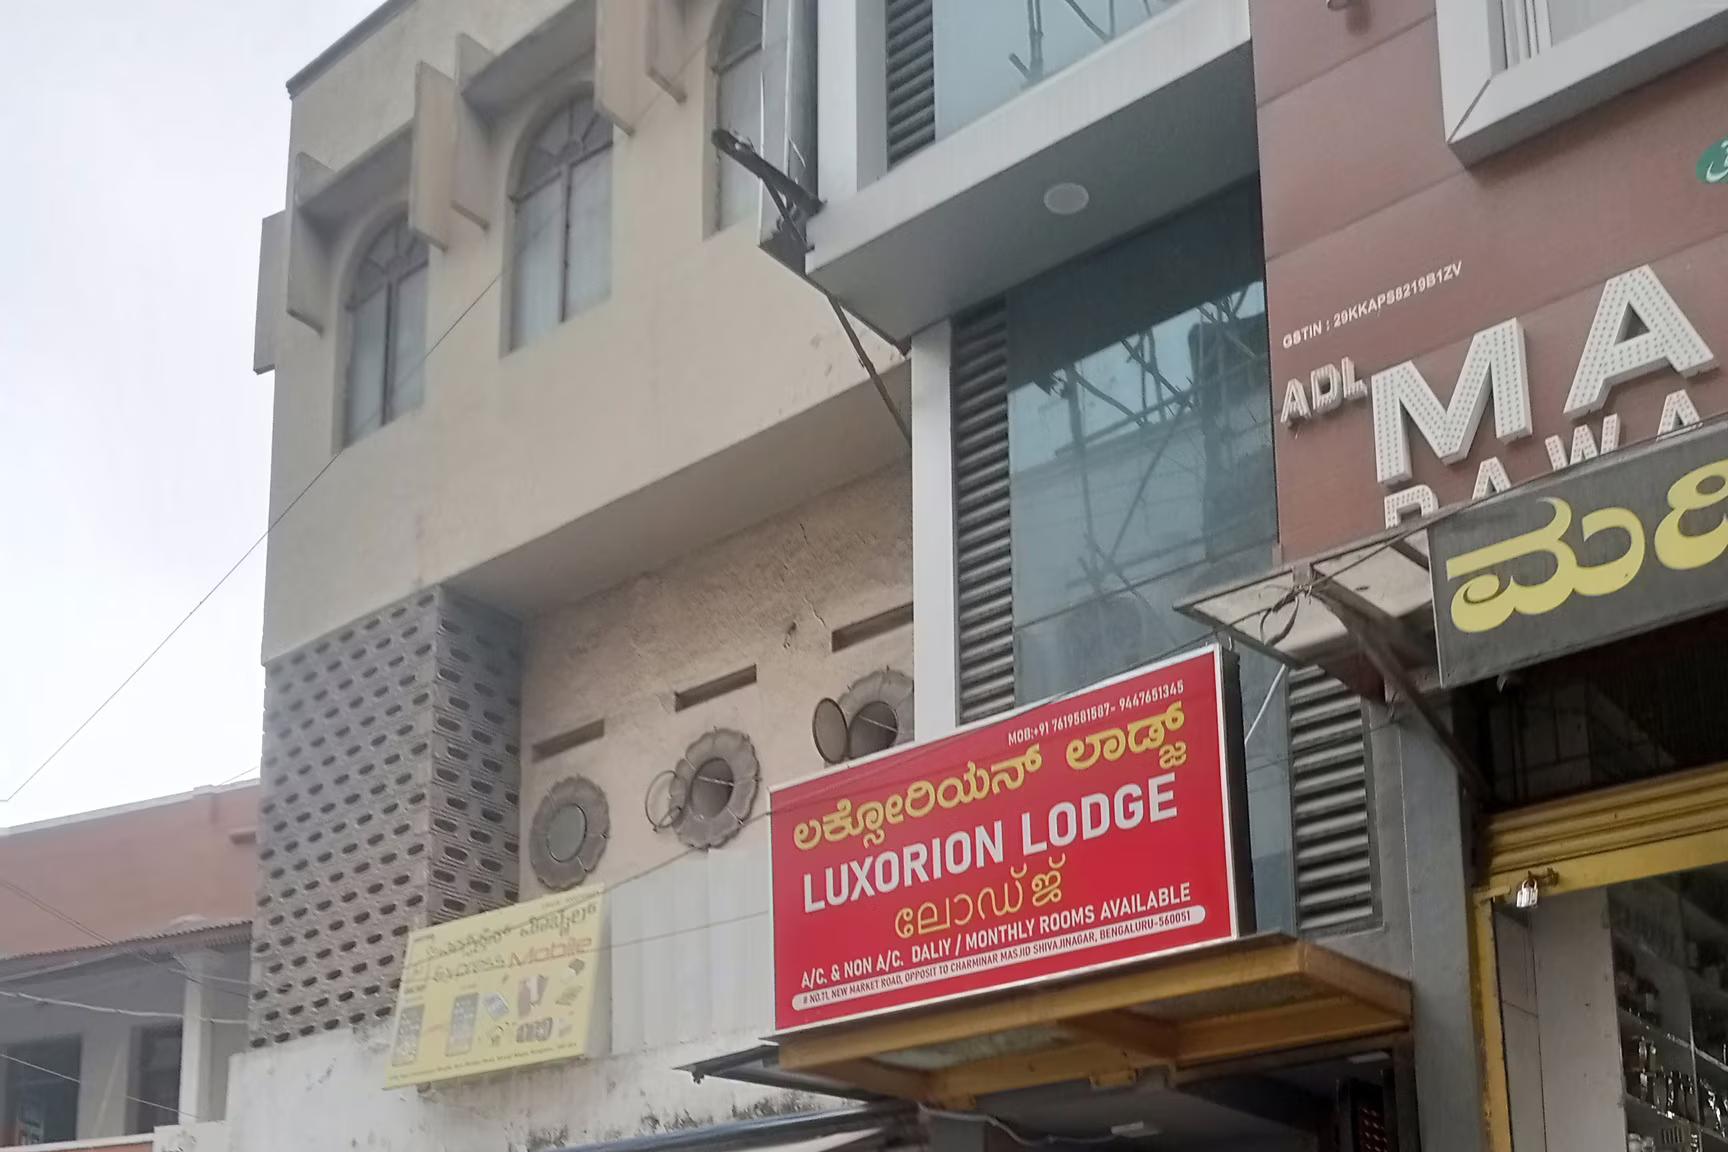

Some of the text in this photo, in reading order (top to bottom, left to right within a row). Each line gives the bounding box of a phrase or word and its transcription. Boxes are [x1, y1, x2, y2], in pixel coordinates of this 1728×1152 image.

[1282, 320, 1322, 349] GSTIN
[1280, 356, 1368, 424] ADL
[803, 772, 1178, 913] LUXORION LODGE
[831, 964, 840, 982] &
[844, 956, 873, 978] NON
[912, 938, 951, 963] DALIY
[955, 933, 962, 956] /
[965, 918, 1035, 951] MONTHLY
[1039, 905, 1095, 934] ROOMS
[1100, 882, 1191, 921] AVAILABLE
[831, 986, 848, 999] NEW
[849, 979, 879, 995] MARKET
[904, 966, 937, 983] OPPOSIT
[939, 964, 949, 976] TO
[950, 955, 999, 972] CHARMINAR
[1000, 946, 1031, 961] MASJID
[1033, 932, 1098, 954] SHIVAJINAGAR,
[1100, 910, 1191, 940] BENGALURU-560051
